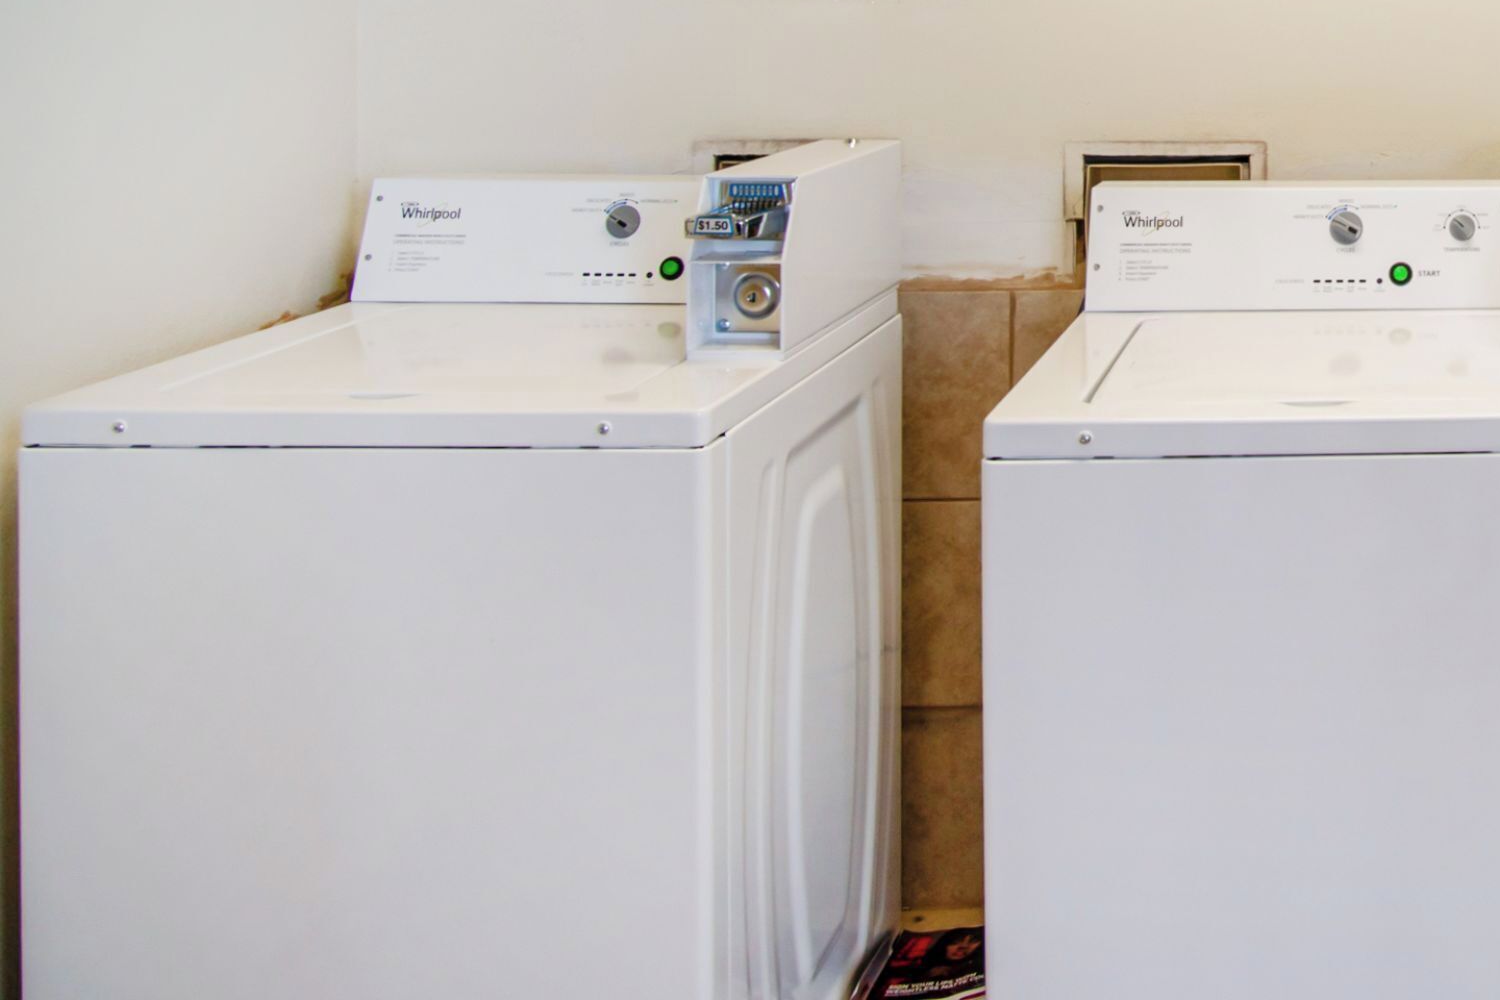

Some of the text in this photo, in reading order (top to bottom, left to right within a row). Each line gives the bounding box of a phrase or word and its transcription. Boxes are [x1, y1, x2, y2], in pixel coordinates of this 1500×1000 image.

[401, 207, 461, 221] Whirlpool
[698, 220, 728, 230] $1.50
[1124, 216, 1183, 230] Whirlpool
